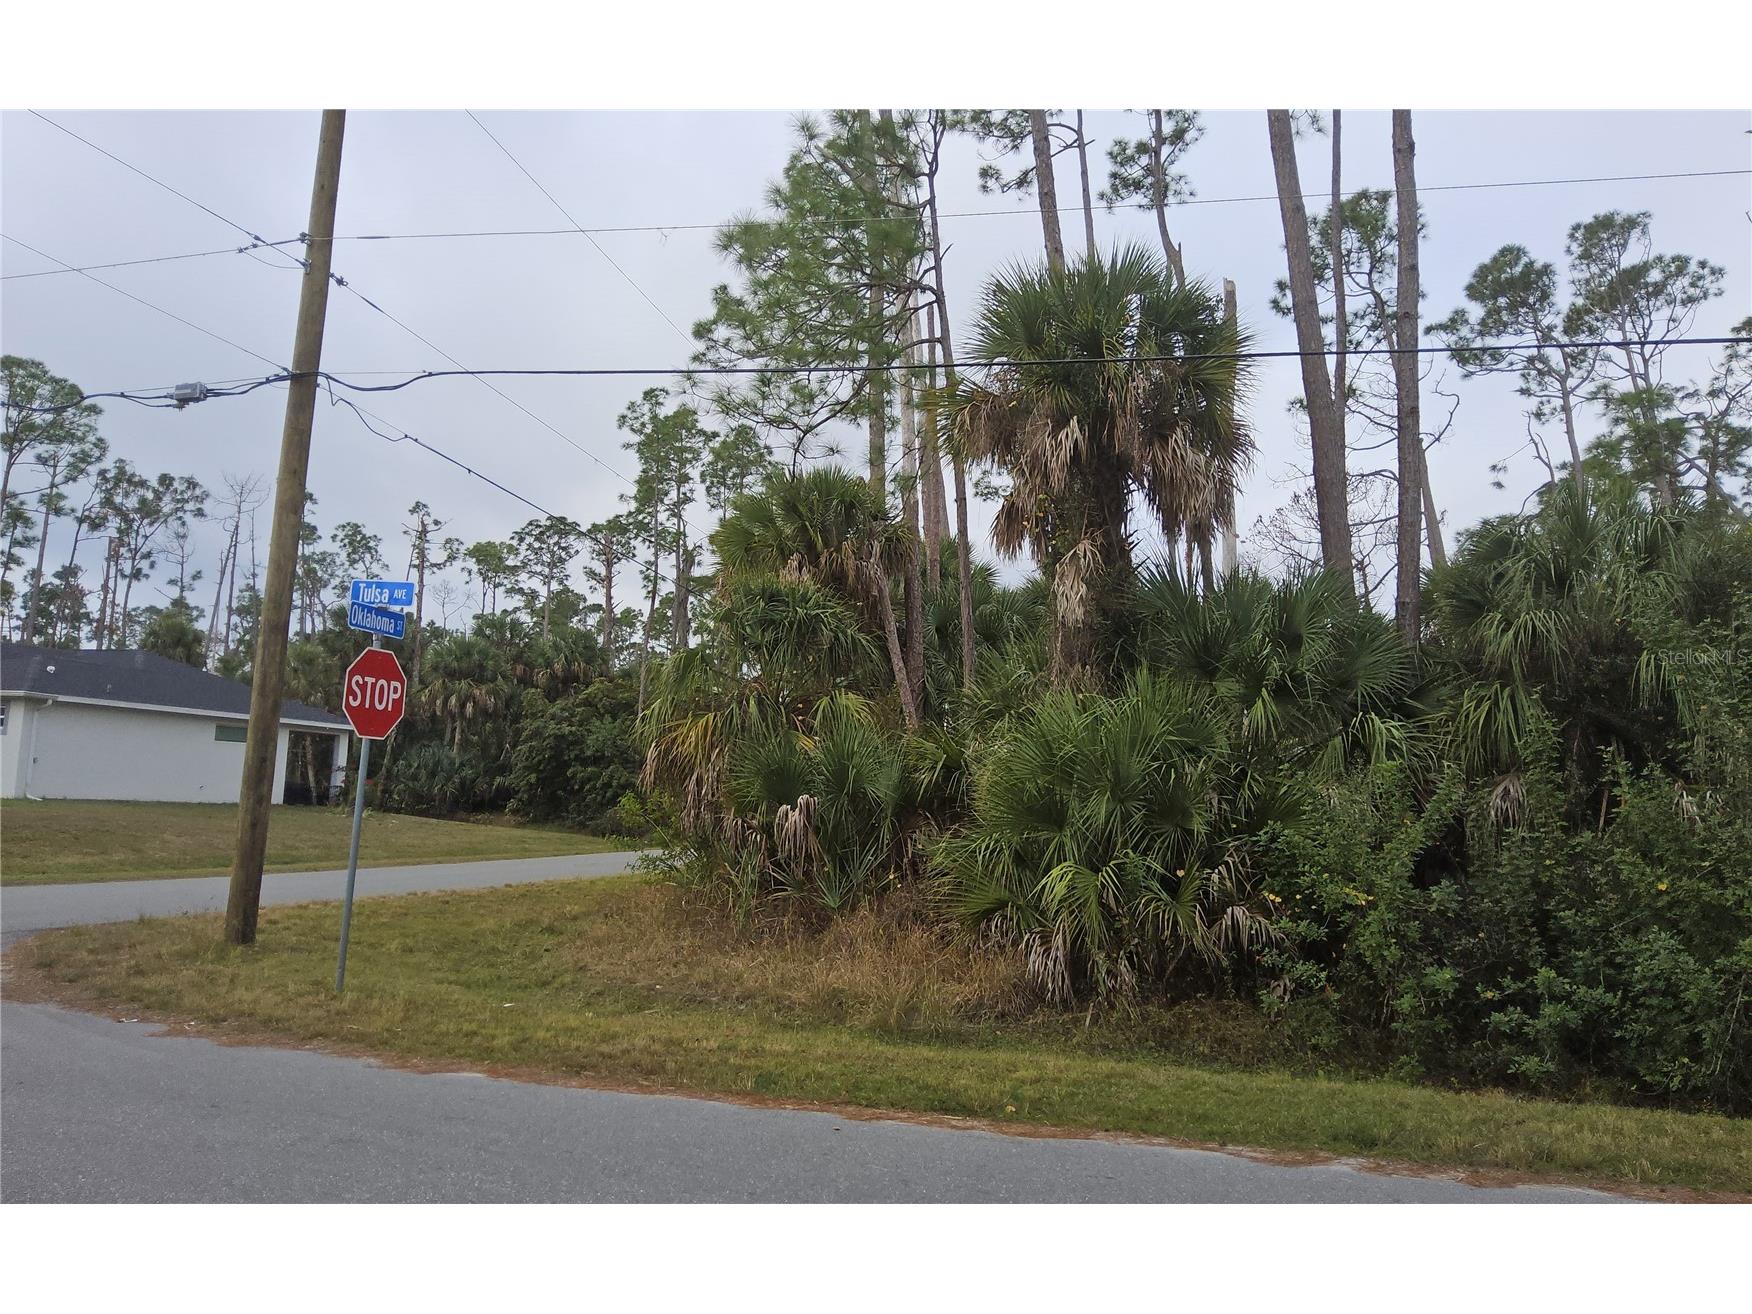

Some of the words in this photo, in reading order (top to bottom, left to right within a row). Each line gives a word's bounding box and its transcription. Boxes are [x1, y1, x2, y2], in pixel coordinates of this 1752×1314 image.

[359, 583, 389, 603] Tulsa
[393, 589, 407, 600] AVE
[351, 604, 395, 633] Oklahoma
[396, 620, 403, 631] ST
[349, 675, 402, 711] STOP
